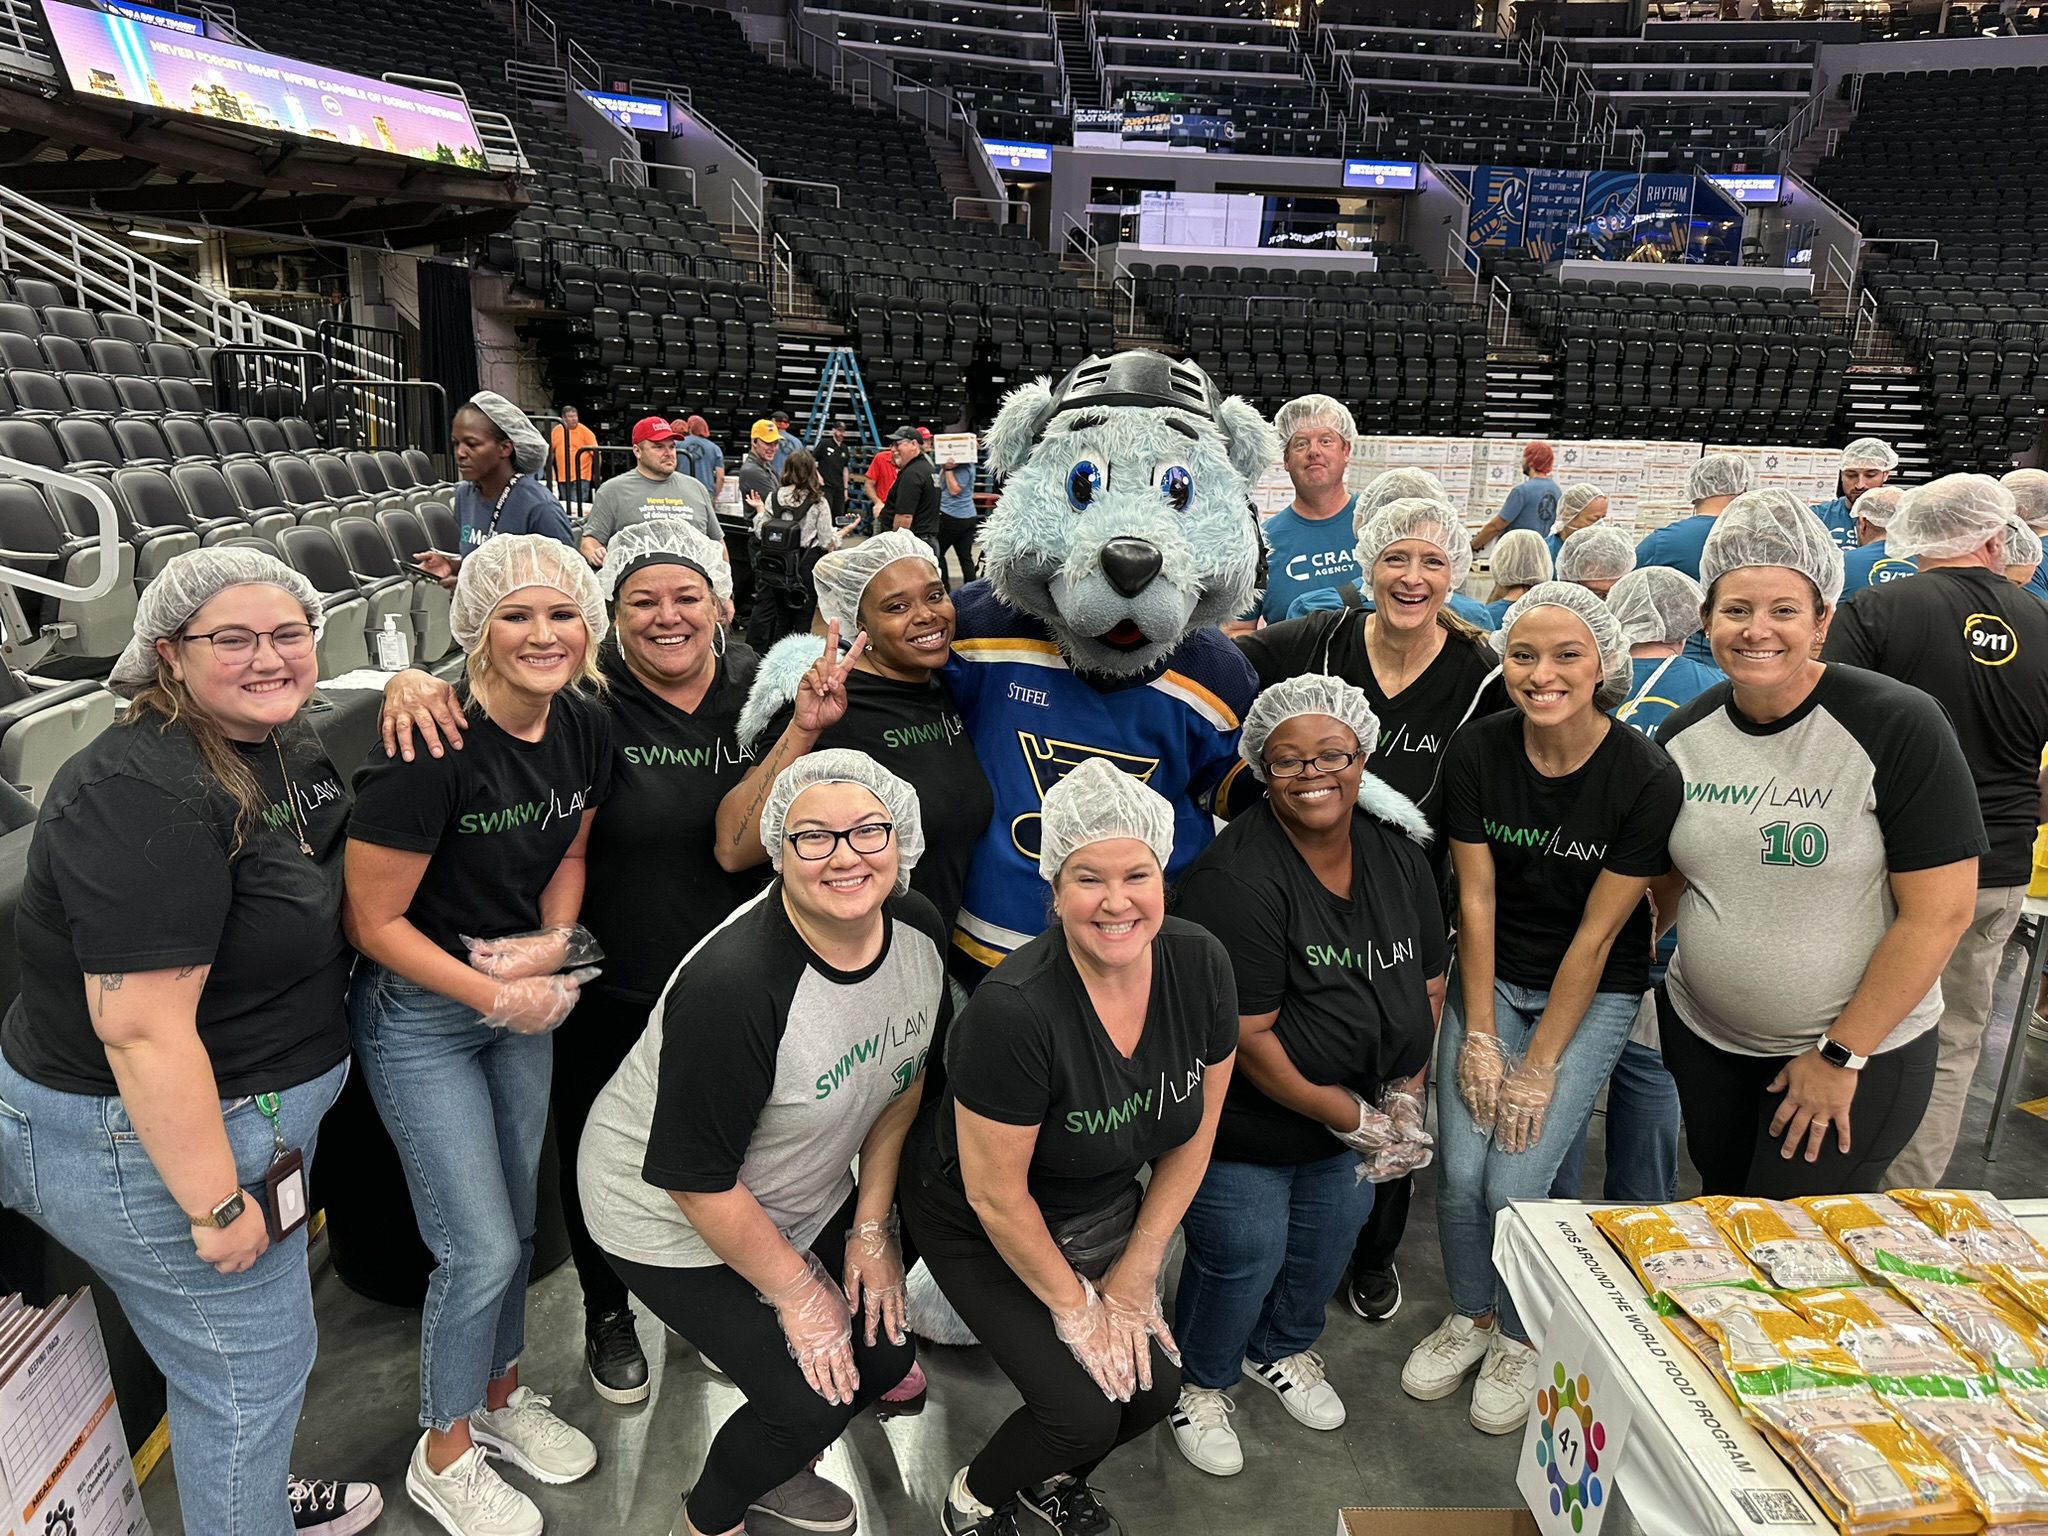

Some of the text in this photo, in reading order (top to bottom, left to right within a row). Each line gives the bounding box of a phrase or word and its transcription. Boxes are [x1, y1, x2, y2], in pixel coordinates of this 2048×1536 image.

[150, 40, 195, 60] NEVER
[196, 51, 243, 71] FORGET
[244, 62, 280, 79] WHAT
[281, 71, 318, 88] WE'RE
[318, 80, 368, 101] CAPABLE
[367, 91, 382, 103] OF
[382, 95, 415, 112] DOING
[614, 82, 627, 91] EXIT
[1733, 163, 1746, 172] EXIT
[1646, 186, 1688, 203] RHYTHM
[639, 504, 655, 513] what
[647, 497, 684, 506] Never forget
[1315, 564, 1354, 577] AGENCY
[1972, 629, 2008, 651] 9/11
[1007, 682, 1050, 707] STIFEL
[262, 777, 341, 831] MW/LAW
[1686, 776, 1833, 815] WMW/LAW
[1483, 825, 1607, 861] WMW/LAW
[1759, 821, 1828, 867] 10
[815, 1006, 928, 1100] SWMW/LAW
[27, 1334, 61, 1378] KEEPING TRACK
[1555, 1220, 1582, 1243] KIDS
[1573, 1242, 1616, 1290] AROUND
[1607, 1291, 1632, 1312] THE
[1625, 1314, 1668, 1358] WORLD
[1658, 1359, 1697, 1397] FOOD
[1688, 1399, 1757, 1474] PROGRAM
[32, 1481, 52, 1509] MEAL
[51, 1453, 70, 1482] PACK
[69, 1435, 83, 1457] FOR
[94, 1403, 108, 1420] DAY
[87, 1458, 110, 1494] OneMeal
